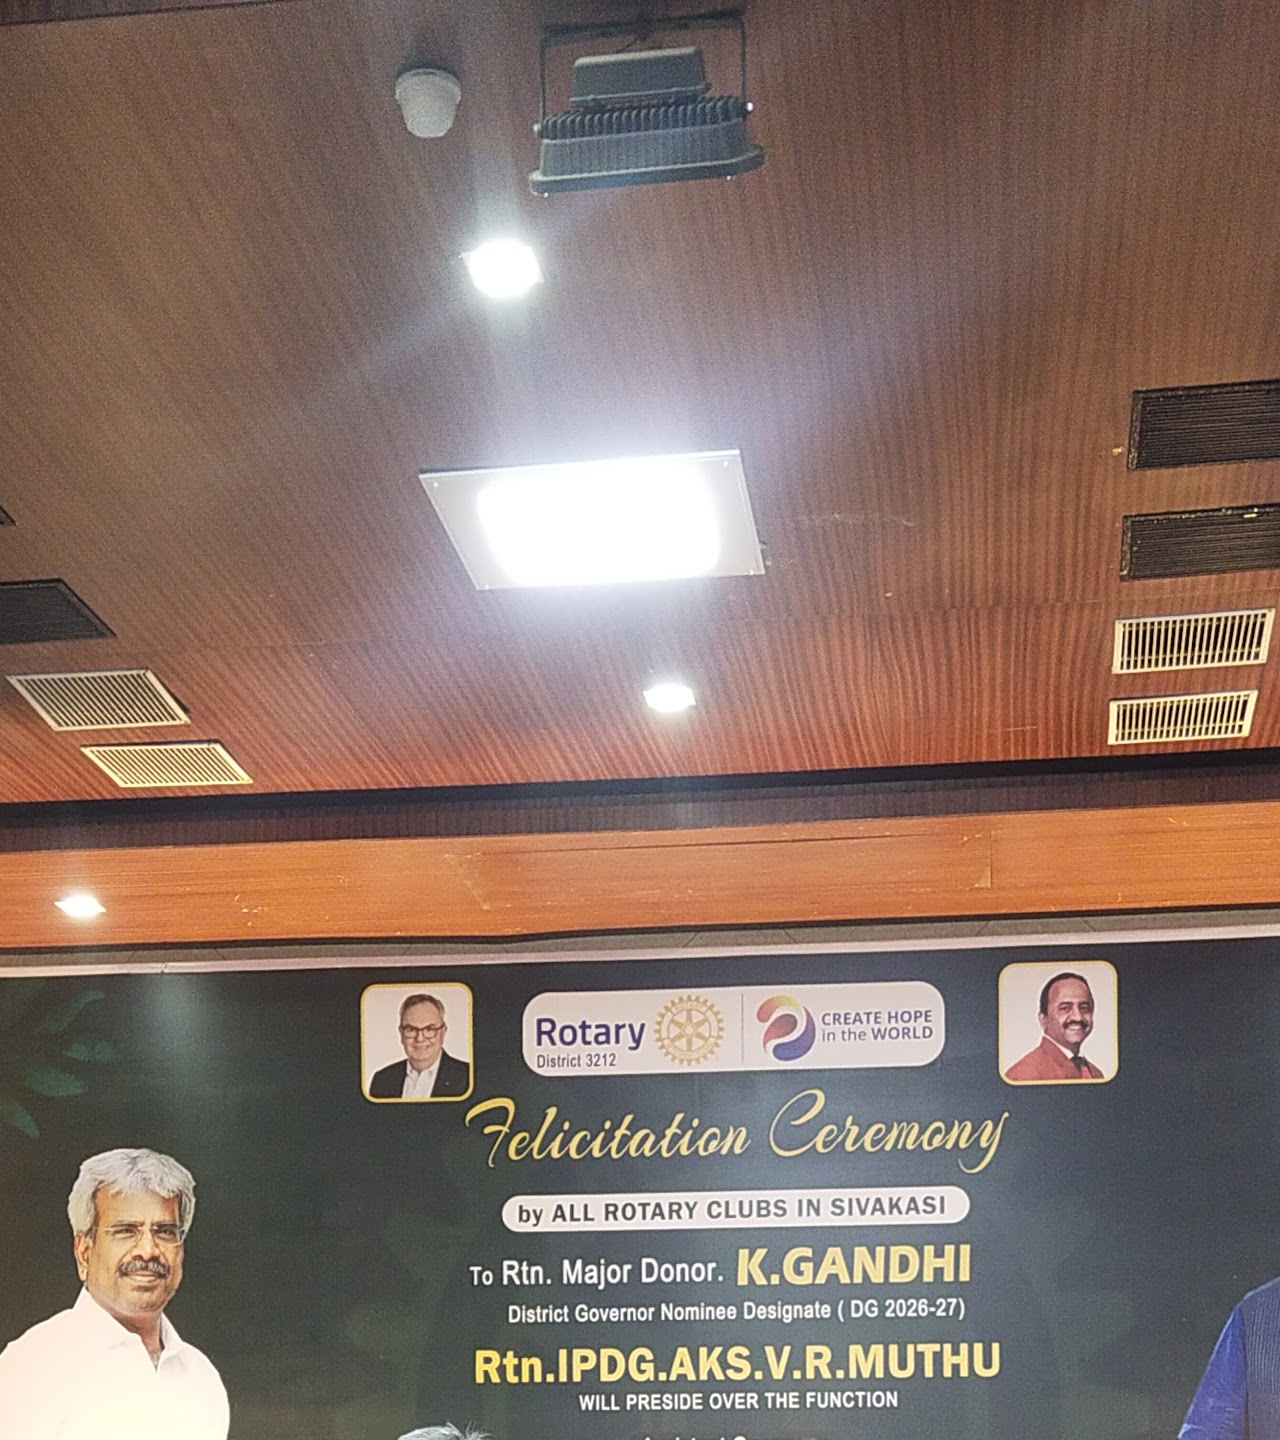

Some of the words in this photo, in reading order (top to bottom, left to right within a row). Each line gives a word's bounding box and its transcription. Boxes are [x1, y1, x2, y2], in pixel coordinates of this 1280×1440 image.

[821, 1011, 883, 1026] CREATE
[888, 1009, 933, 1024] HOPE
[536, 1018, 647, 1051] Rotary
[822, 1029, 838, 1042] in
[840, 1028, 867, 1041] the
[871, 1026, 933, 1041] WORLD
[536, 1053, 582, 1068] District
[586, 1053, 616, 1068] 3212
[465, 1097, 751, 1168] Felicitation
[769, 1089, 1010, 1173] Ceremony
[518, 1205, 543, 1227] by
[552, 1204, 595, 1223] ALL
[604, 1201, 699, 1221] ROTARY
[706, 1199, 788, 1218] CLUBS
[798, 1199, 820, 1217] IN
[830, 1196, 946, 1217] SIVAKASI
[469, 1266, 494, 1286] To
[502, 1260, 552, 1286] Rtn.
[562, 1258, 632, 1290] Major
[641, 1258, 724, 1283] Donor.
[736, 1244, 971, 1286] K.GANDHI
[508, 1304, 569, 1323] District
[574, 1304, 655, 1322] Governor
[660, 1302, 737, 1320] Nominee
[743, 1301, 831, 1323] Designate
[850, 1299, 879, 1317] DG
[885, 1298, 966, 1320] 2026-27)
[474, 1342, 1001, 1384] Rtn.IPDG.AKS.V.R.MUTHU
[579, 1395, 620, 1411] WILL
[626, 1393, 703, 1410] PRESIDE
[709, 1393, 759, 1409] OVER
[764, 1392, 800, 1409] THE
[806, 1391, 898, 1408] FUNCTION
